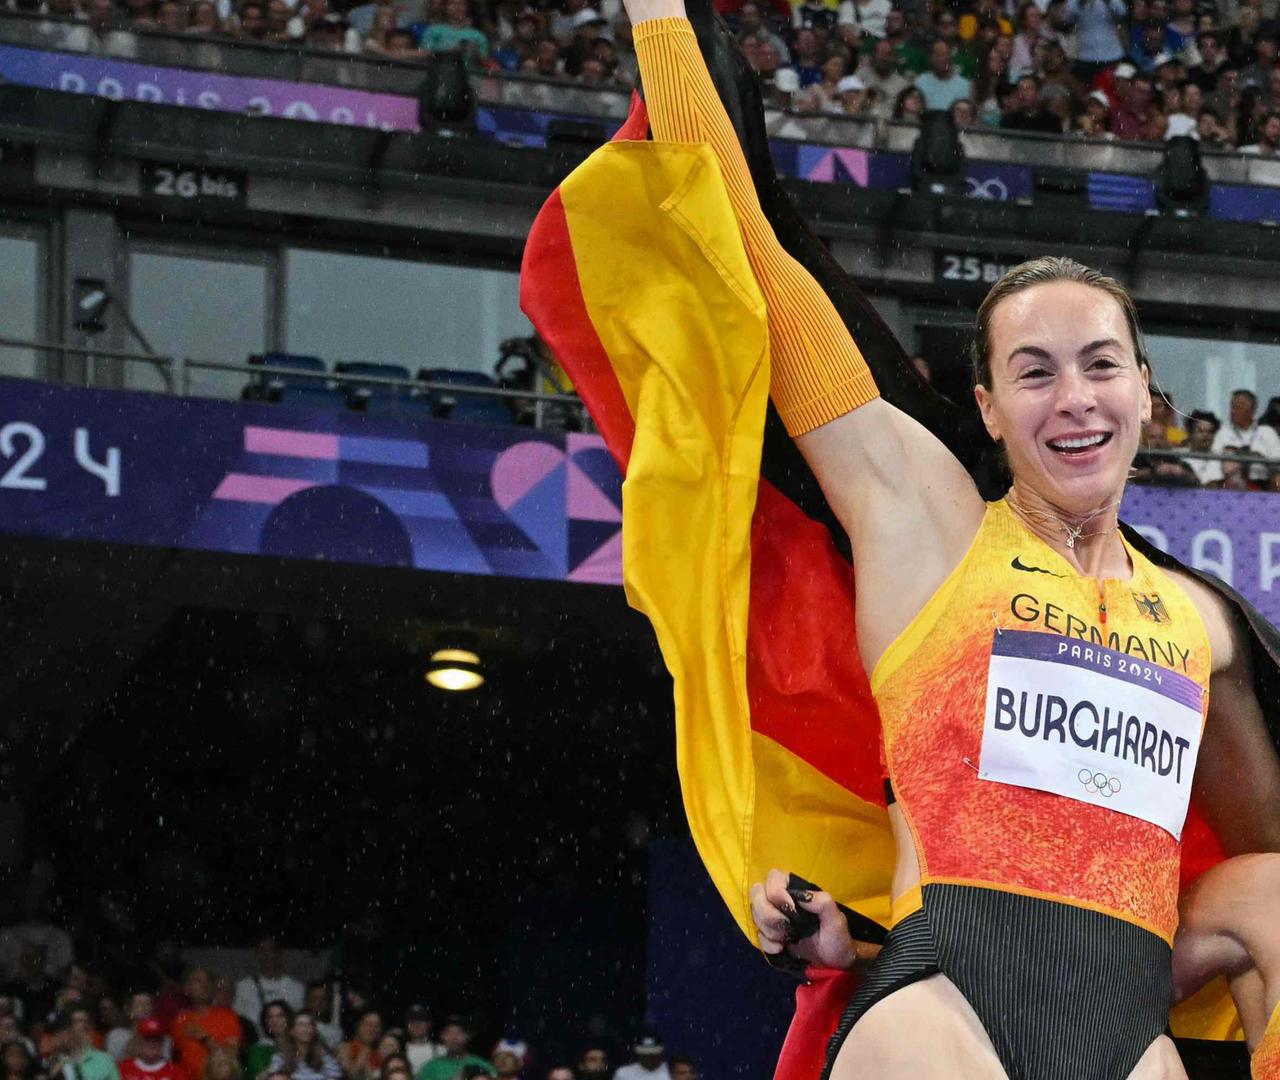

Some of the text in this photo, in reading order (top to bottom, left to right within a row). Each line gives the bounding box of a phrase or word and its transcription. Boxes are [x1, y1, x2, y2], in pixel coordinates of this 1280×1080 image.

[1010, 593, 1190, 674] GERMANY
[1058, 641, 1163, 685] PARiS 2024
[993, 686, 1190, 784] BURGHARDT
